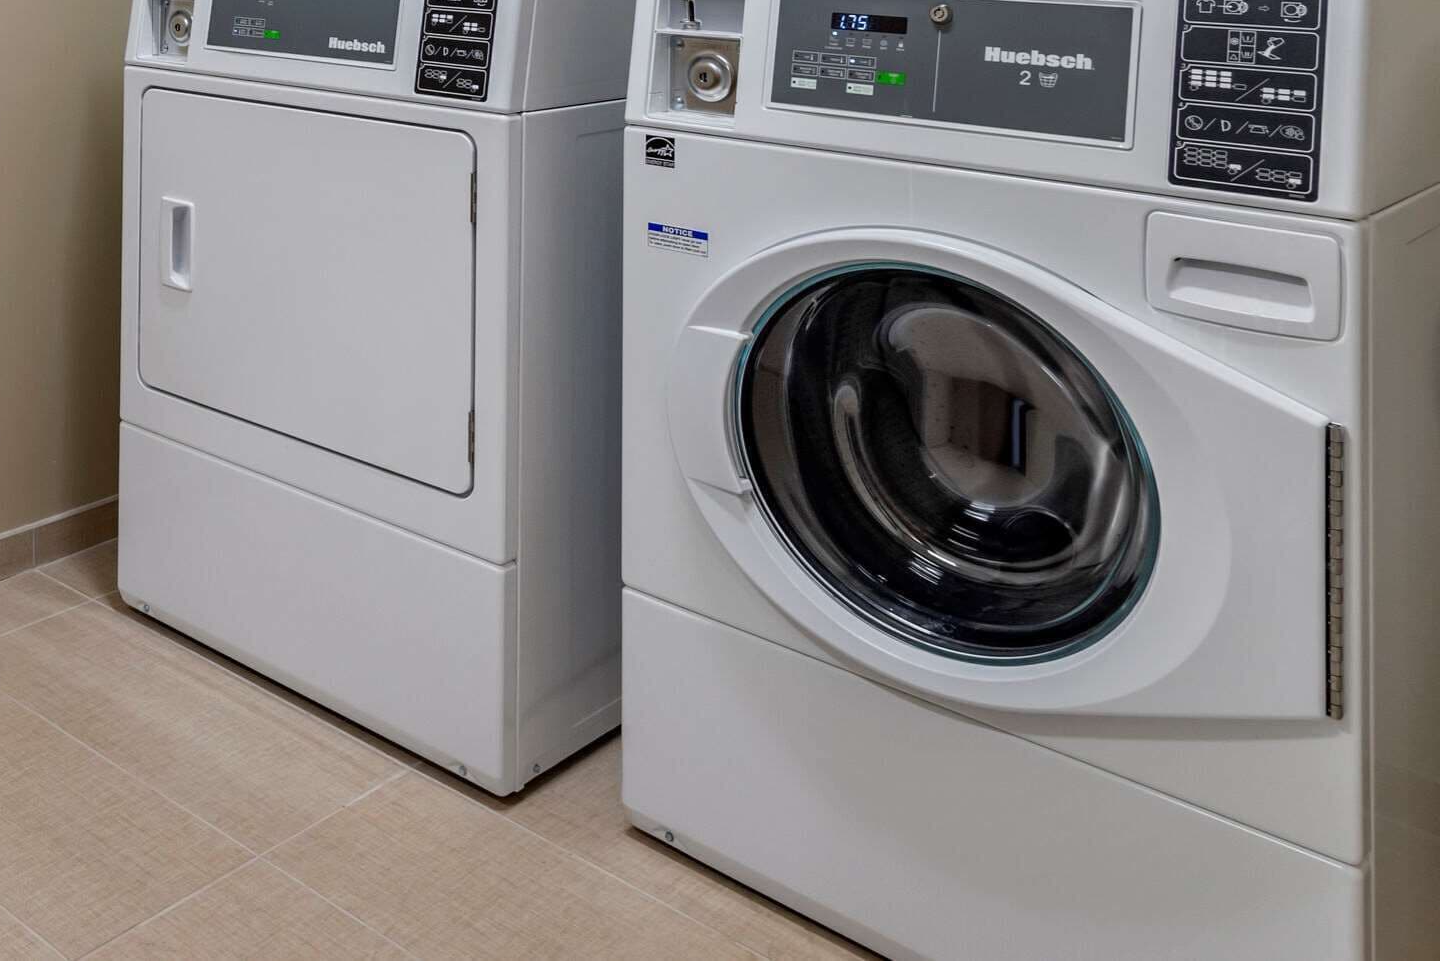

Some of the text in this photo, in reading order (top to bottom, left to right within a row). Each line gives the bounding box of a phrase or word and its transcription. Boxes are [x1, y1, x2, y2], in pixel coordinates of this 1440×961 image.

[839, 14, 869, 31] 1.75
[328, 36, 386, 54] Huebsch
[984, 46, 1093, 70] Huebsch
[1018, 70, 1032, 86] 2
[662, 225, 694, 238] NOTICE
